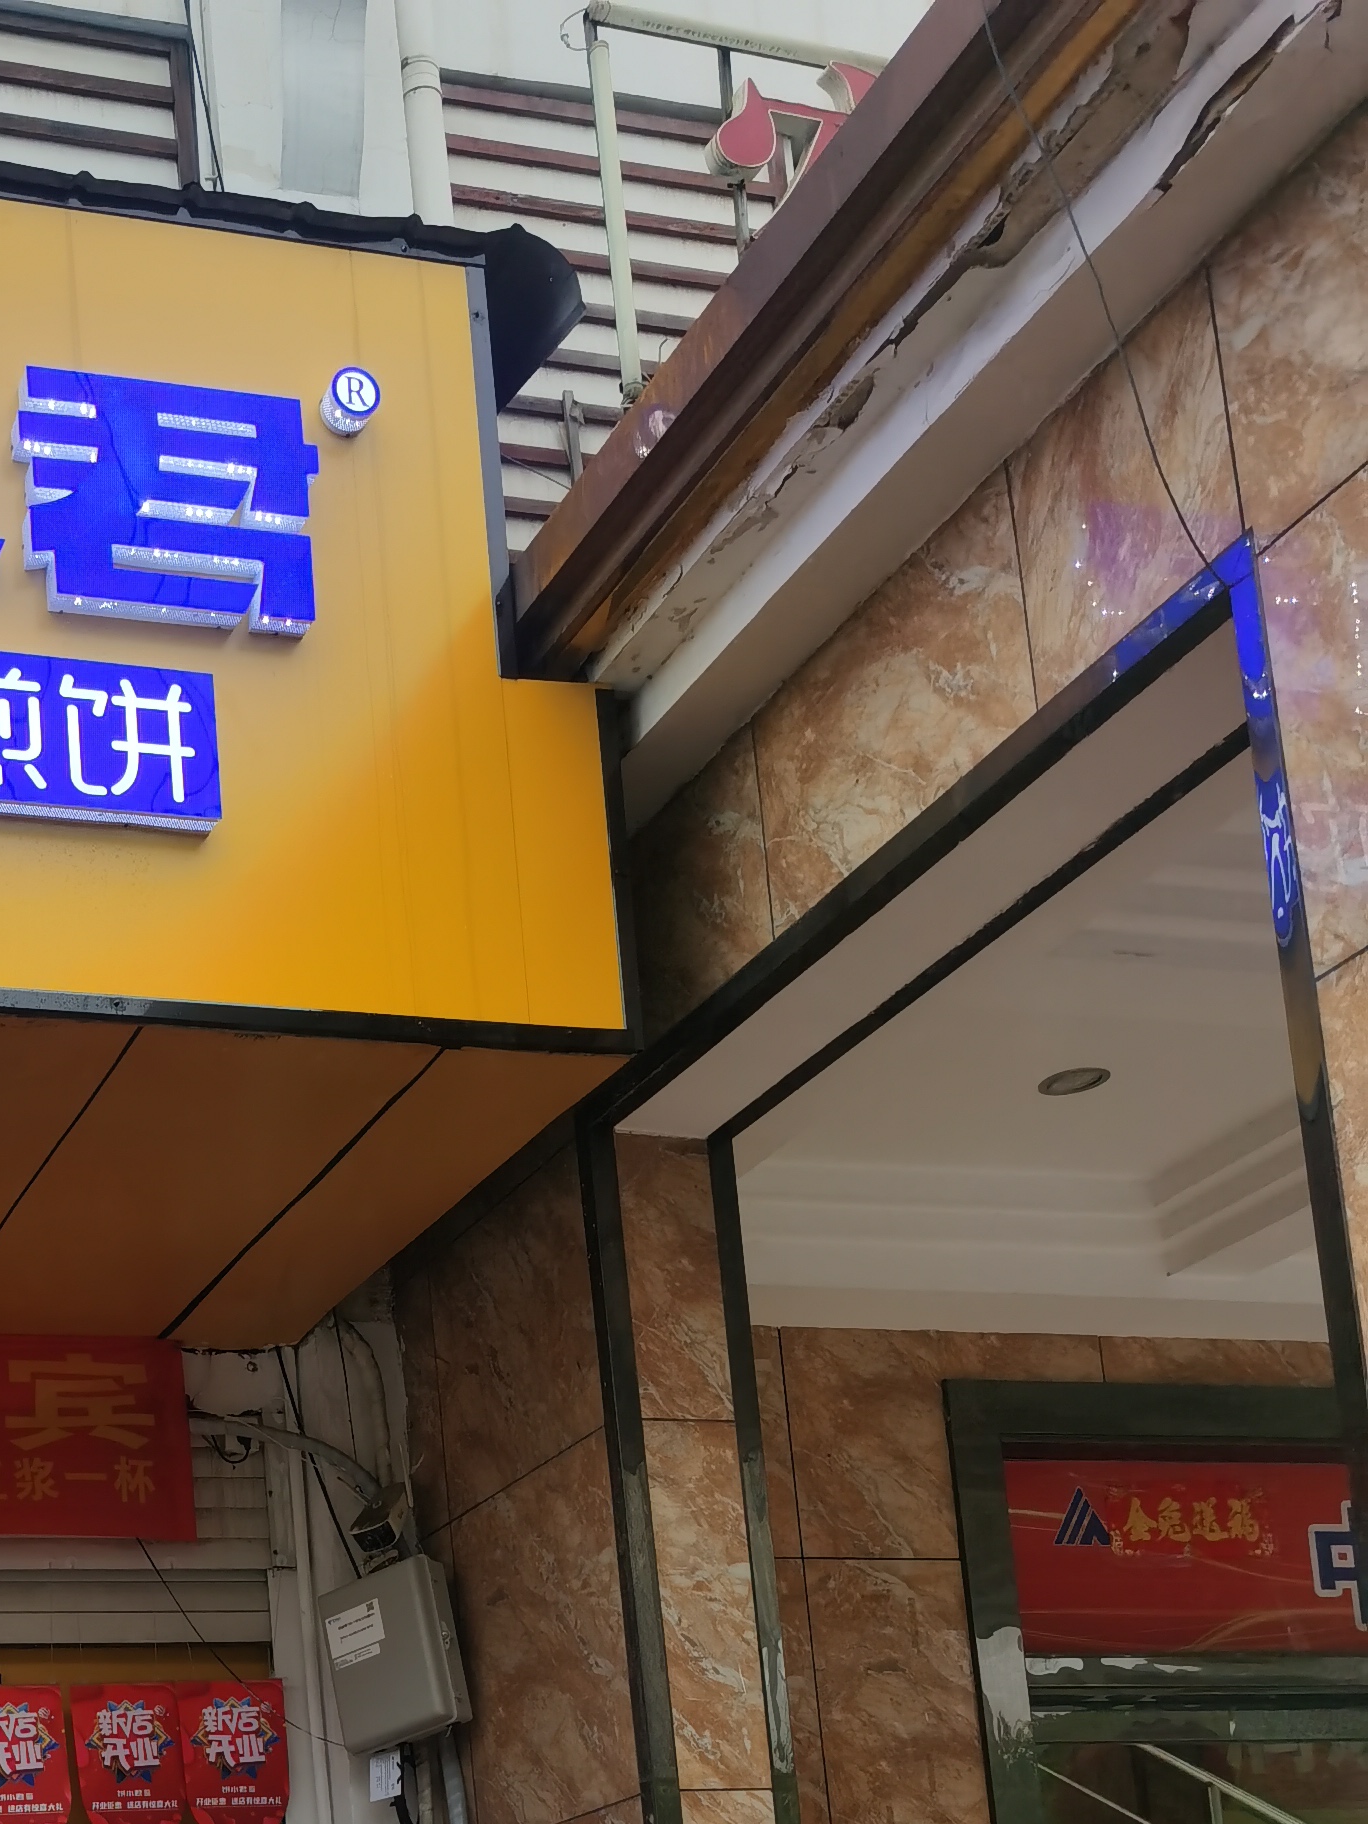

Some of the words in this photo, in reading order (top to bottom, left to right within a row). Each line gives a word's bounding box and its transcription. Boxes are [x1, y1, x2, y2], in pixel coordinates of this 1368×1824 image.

[97, 1709, 154, 1738] 新店
[202, 1705, 259, 1734] 新店
[101, 1737, 160, 1771] 开业
[206, 1733, 265, 1767] 开业
